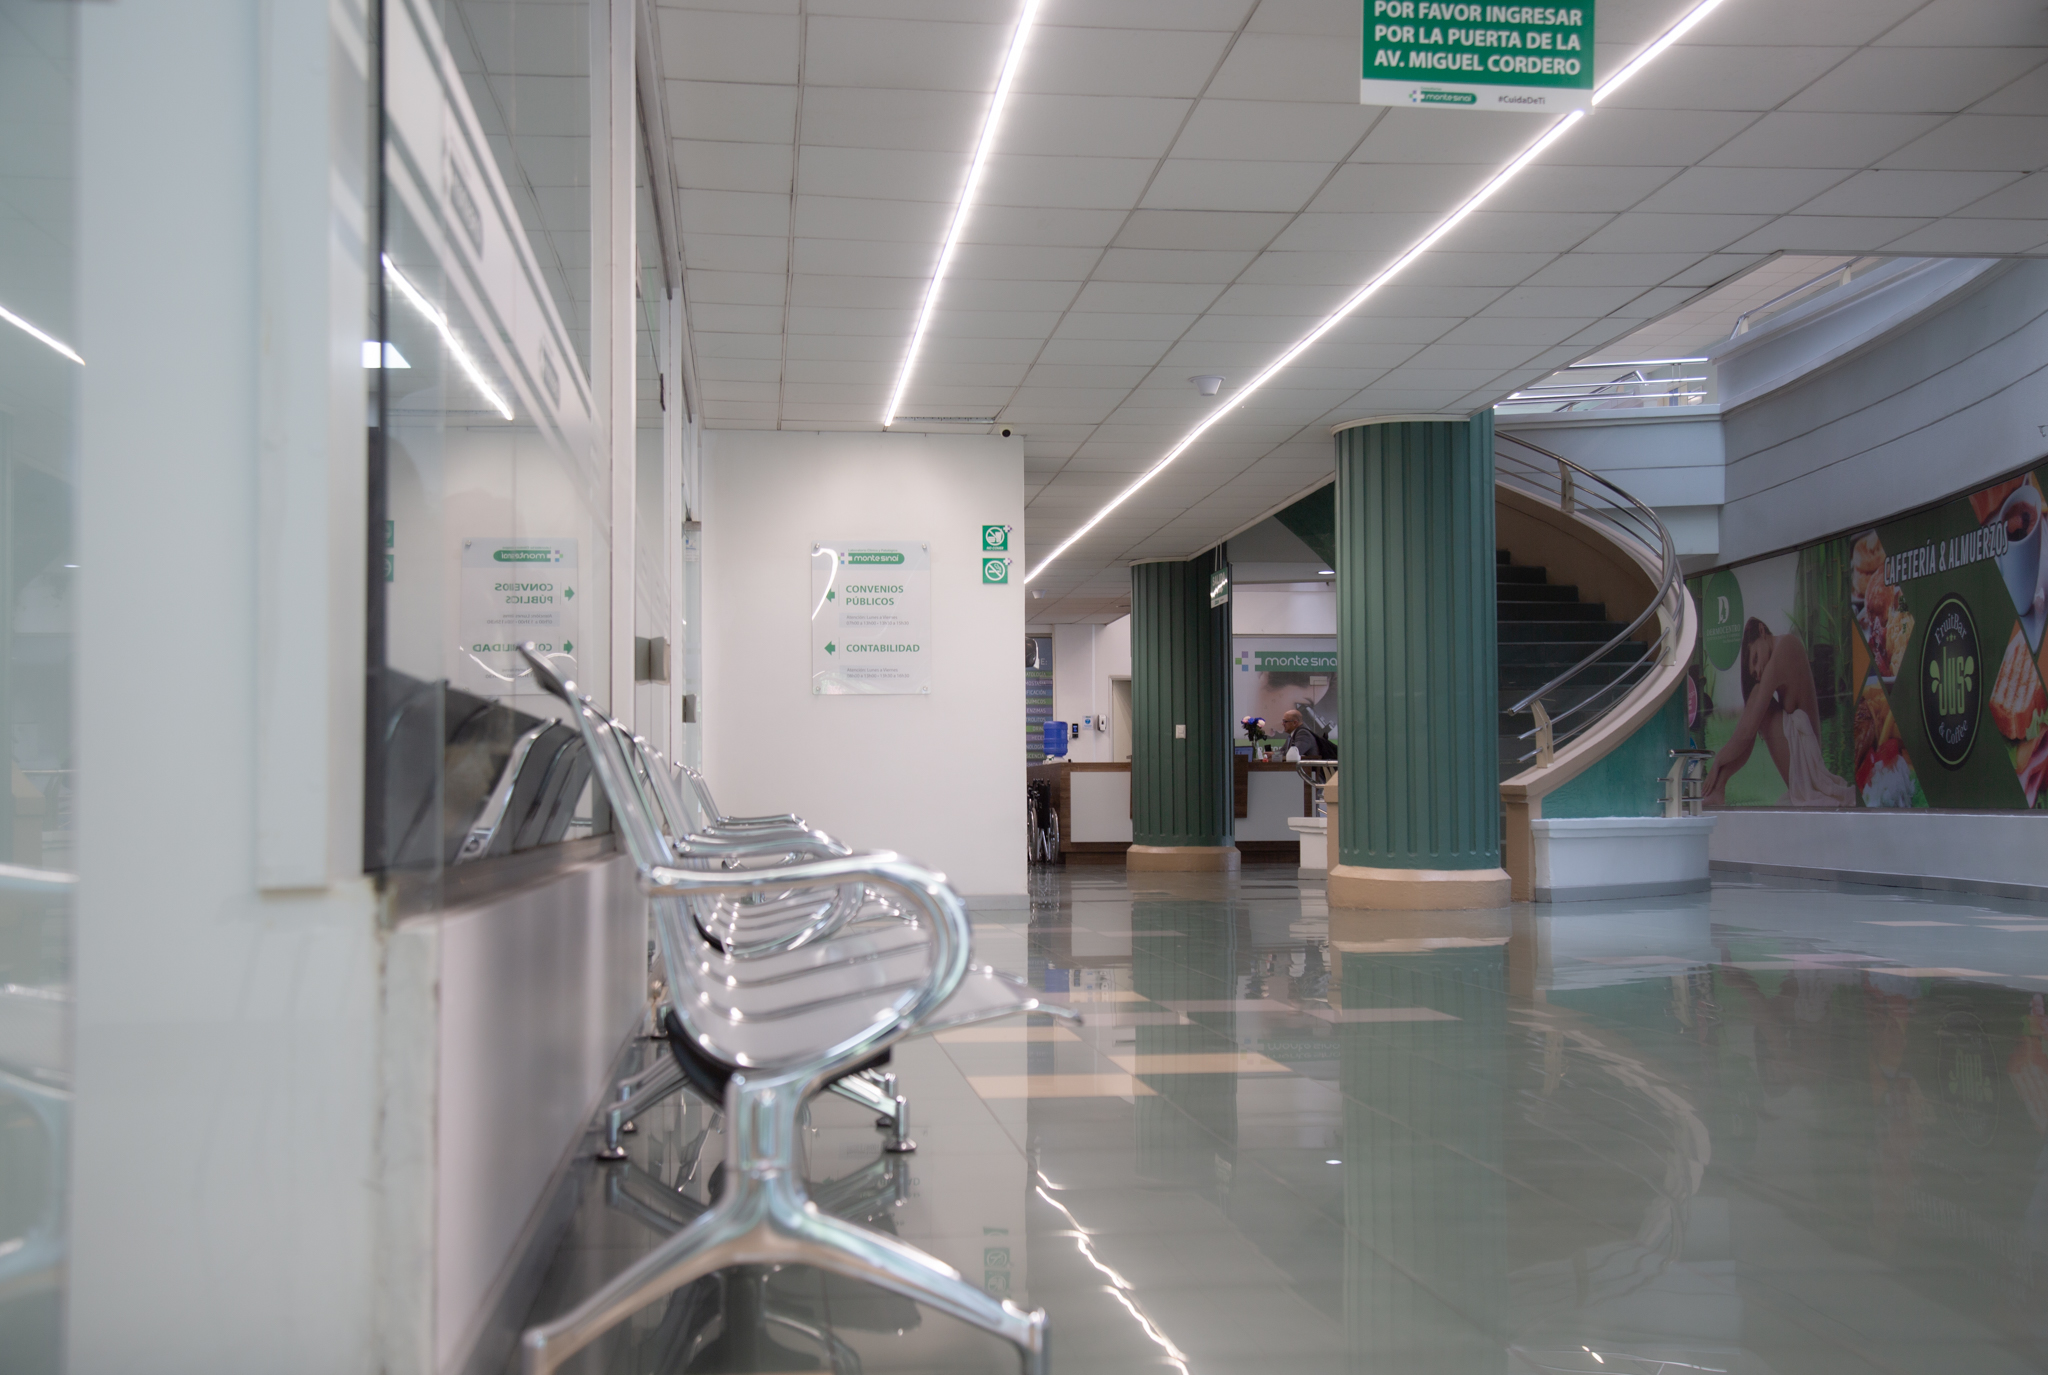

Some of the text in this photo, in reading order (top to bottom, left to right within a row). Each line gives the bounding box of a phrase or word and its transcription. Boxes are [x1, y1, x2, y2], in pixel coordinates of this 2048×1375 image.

[1374, 0, 1582, 26] POR FAVOR INGRESAR
[1374, 25, 1581, 51] POR LA PUERTA DE LA
[1374, 49, 1581, 76] AV. MIGUEL CORDERO
[1498, 96, 1546, 105] #CuidaDeTi
[1884, 521, 2009, 586] CAFETERÍA & ALMUERZOS
[846, 585, 904, 593] CONVENIOS
[846, 595, 895, 606] PÚBLICOS
[846, 644, 920, 653] CONTABILIDAD
